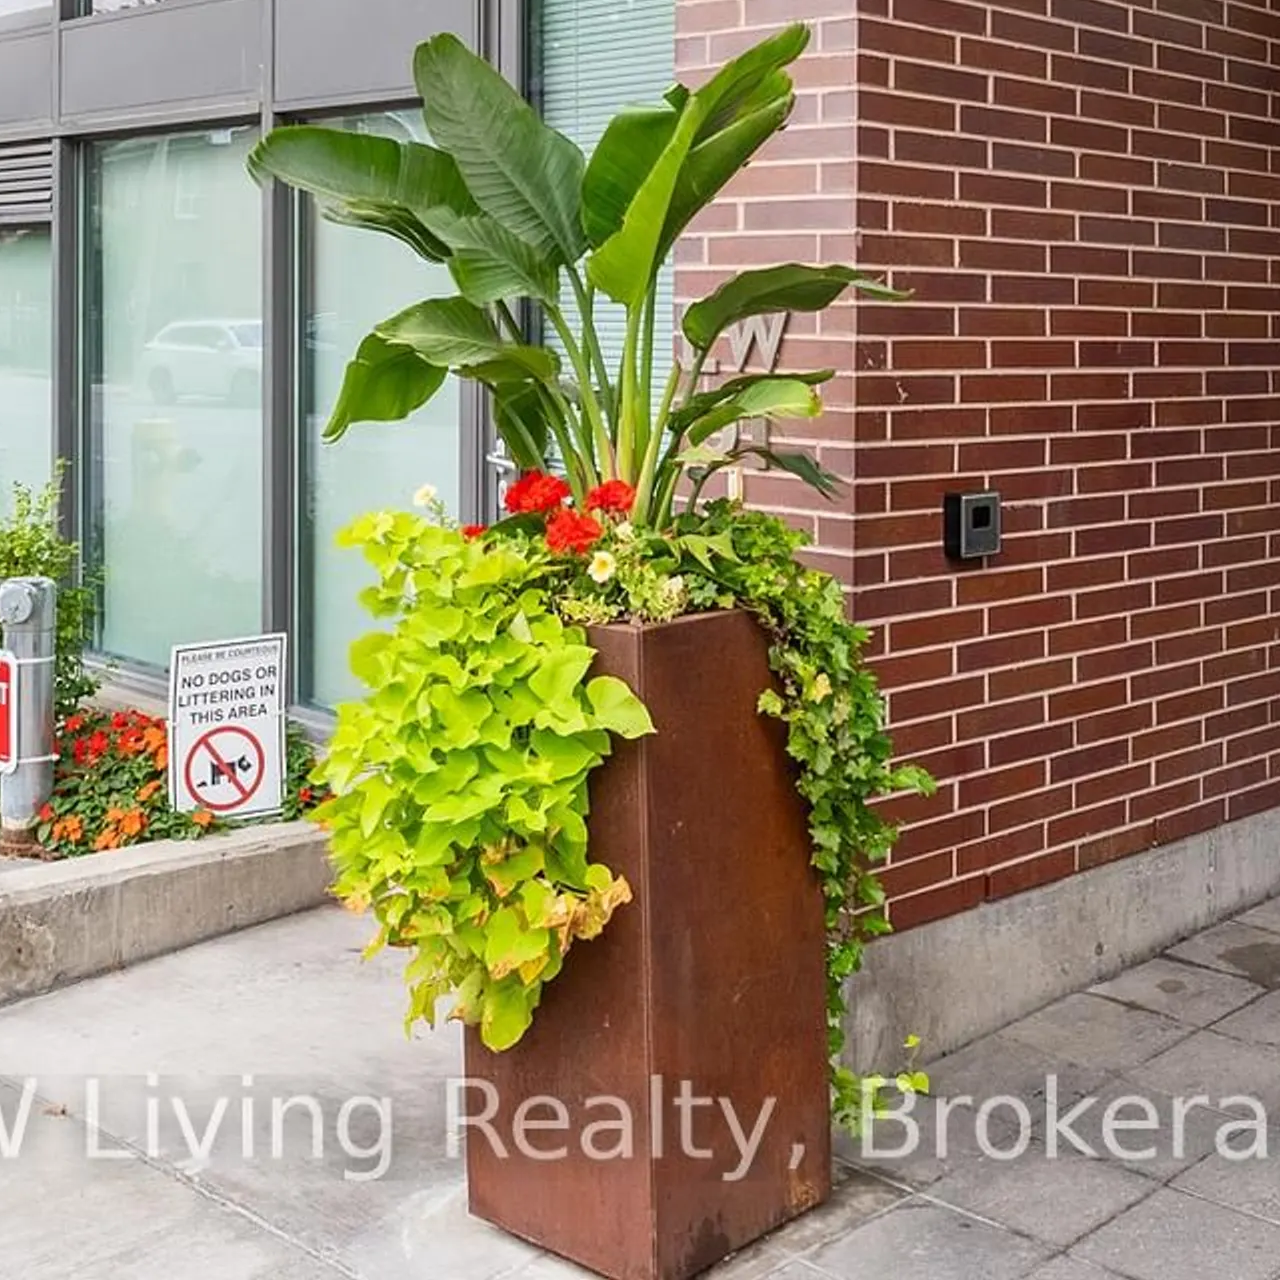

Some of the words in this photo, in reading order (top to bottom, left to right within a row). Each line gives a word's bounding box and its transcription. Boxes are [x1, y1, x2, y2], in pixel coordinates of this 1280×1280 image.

[181, 674, 204, 689] NO
[208, 668, 252, 686] DOGS
[255, 665, 278, 680] OR
[178, 685, 256, 708] LITTERING
[260, 683, 276, 697] IN
[190, 708, 224, 725] THIS
[227, 703, 268, 720] AREA
